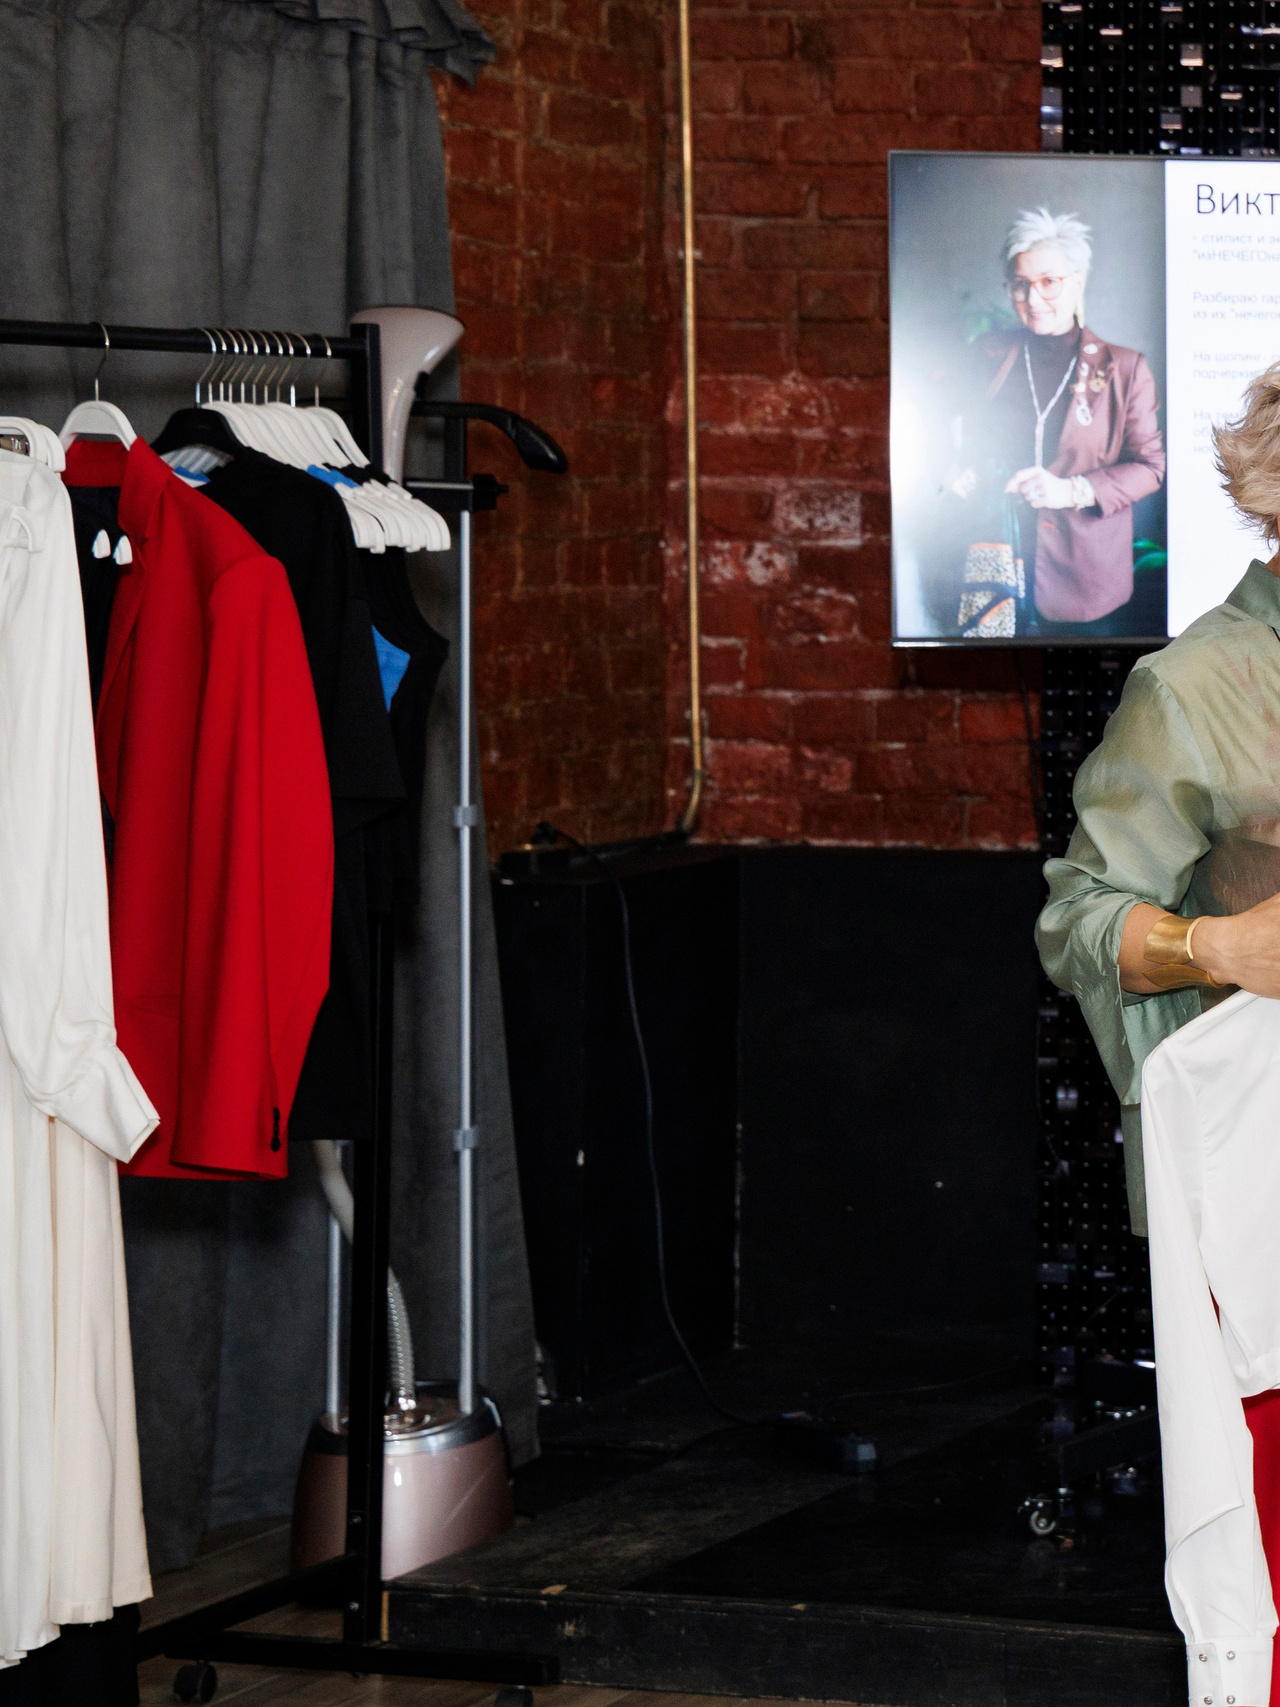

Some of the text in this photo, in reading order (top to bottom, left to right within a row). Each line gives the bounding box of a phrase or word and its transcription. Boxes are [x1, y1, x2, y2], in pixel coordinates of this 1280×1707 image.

[1201, 234, 1252, 245] стилист
[1257, 236, 1265, 245] и
[1193, 292, 1257, 305] Разбираю
[1193, 310, 1207, 320] из
[1211, 310, 1225, 320] их
[1193, 351, 1211, 362] На
[1193, 410, 1211, 420] На
